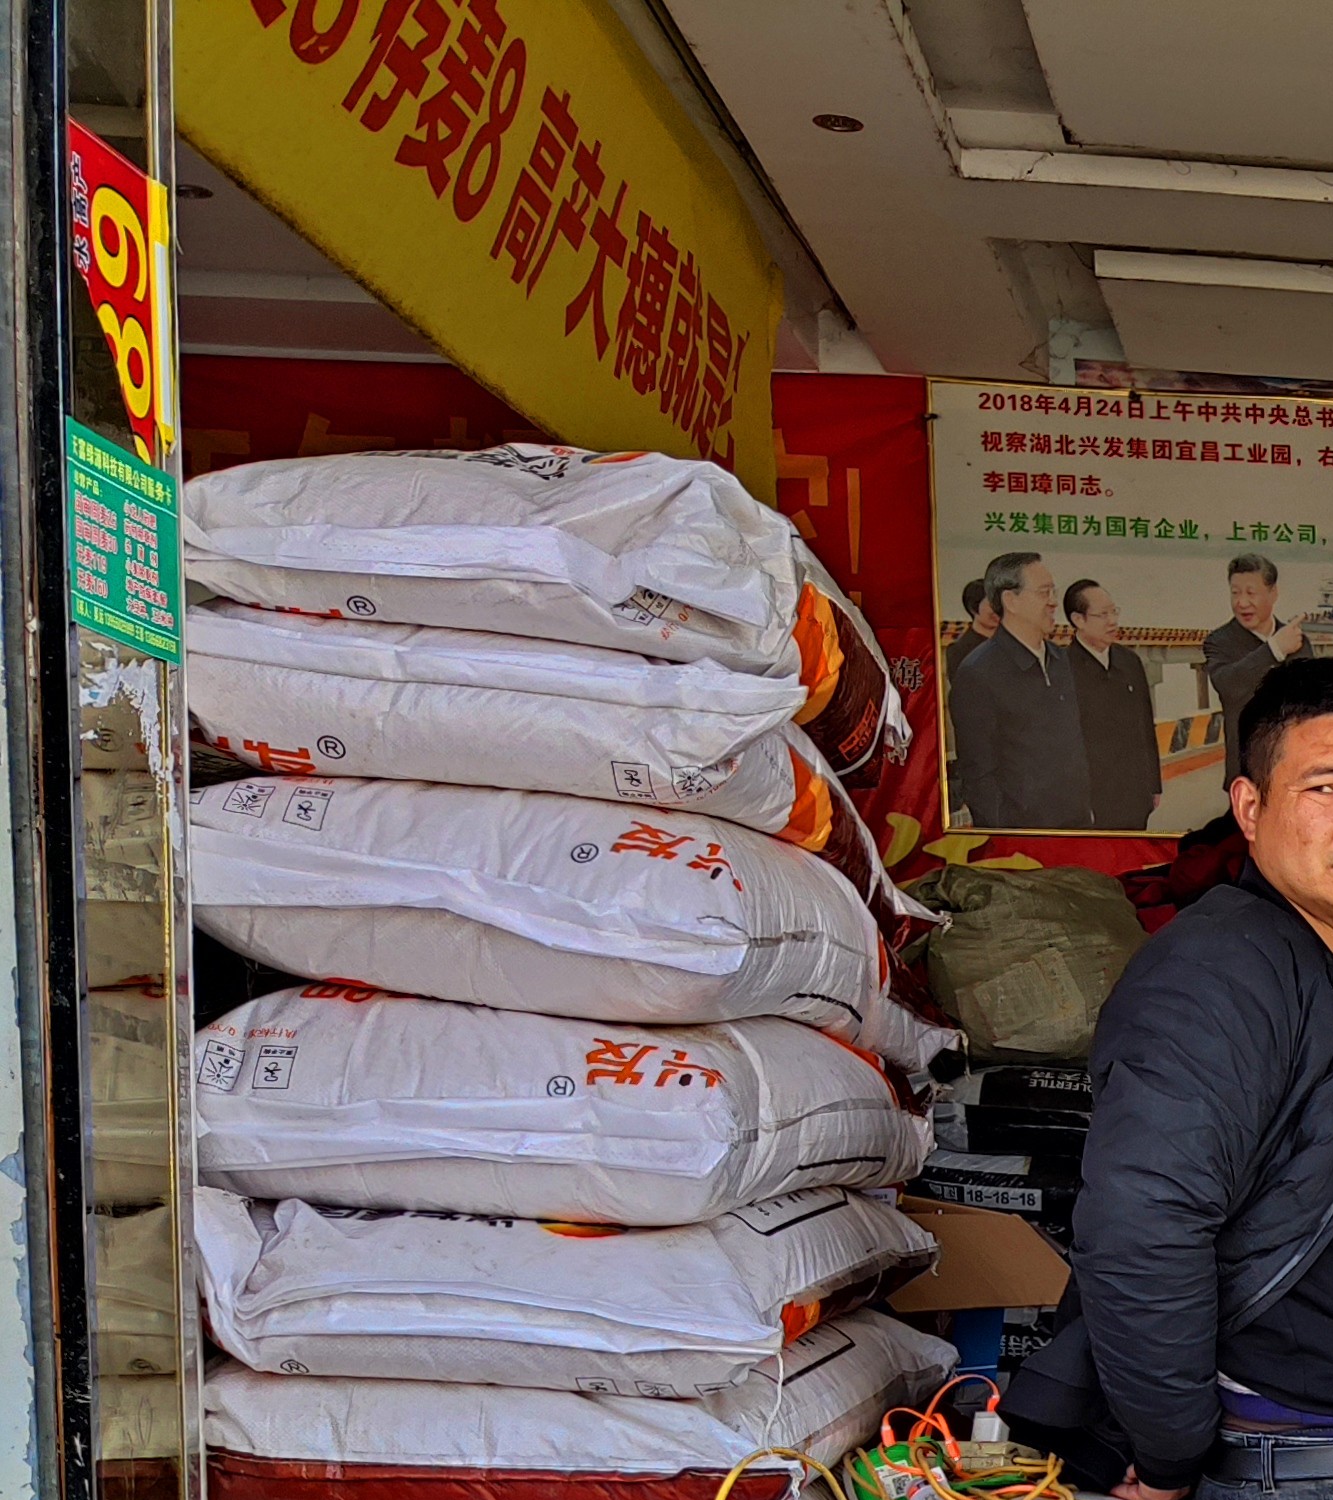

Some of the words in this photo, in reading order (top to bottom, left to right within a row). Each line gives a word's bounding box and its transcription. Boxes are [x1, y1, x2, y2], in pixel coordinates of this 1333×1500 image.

[982, 470, 1117, 498] 李国璋同志。
[586, 1037, 728, 1090] 兴发
